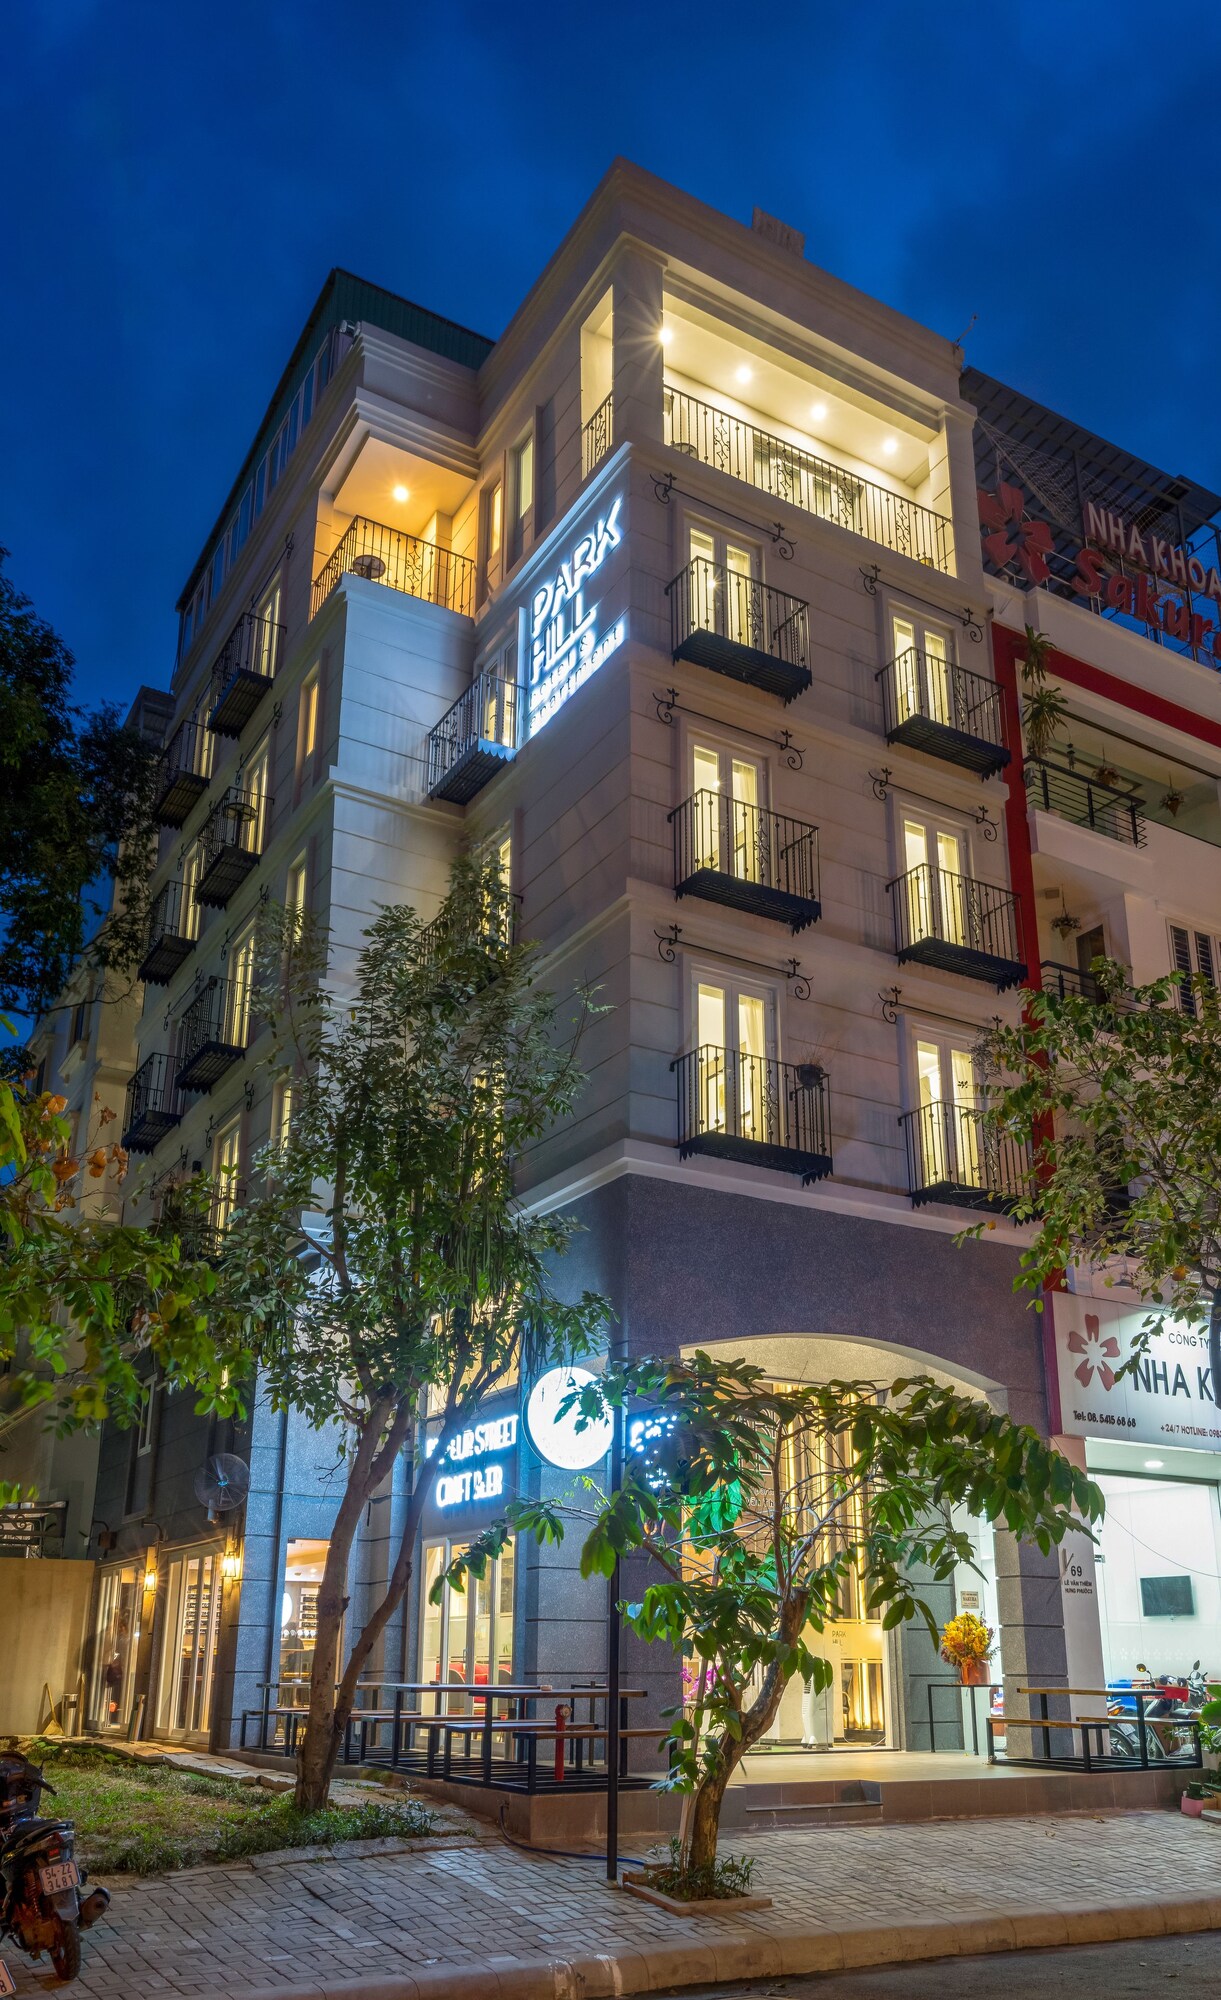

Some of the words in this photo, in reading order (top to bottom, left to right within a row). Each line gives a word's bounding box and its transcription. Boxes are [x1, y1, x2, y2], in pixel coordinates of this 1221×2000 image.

[1084, 501, 1147, 565] NHA
[1151, 536, 1221, 602] KHOA
[531, 494, 623, 638] PARK
[530, 590, 597, 687] HILL
[579, 631, 596, 660] &
[1168, 1331, 1197, 1347] CÔNG
[1199, 1337, 1209, 1349] TY
[1132, 1358, 1191, 1398] NHA
[1072, 1410, 1086, 1421] Tel:
[1126, 1417, 1137, 1428] 68
[1181, 1425, 1208, 1437] HOTLINE:
[1071, 1565, 1083, 1577] 69
[47, 1874, 74, 1892] 3481
